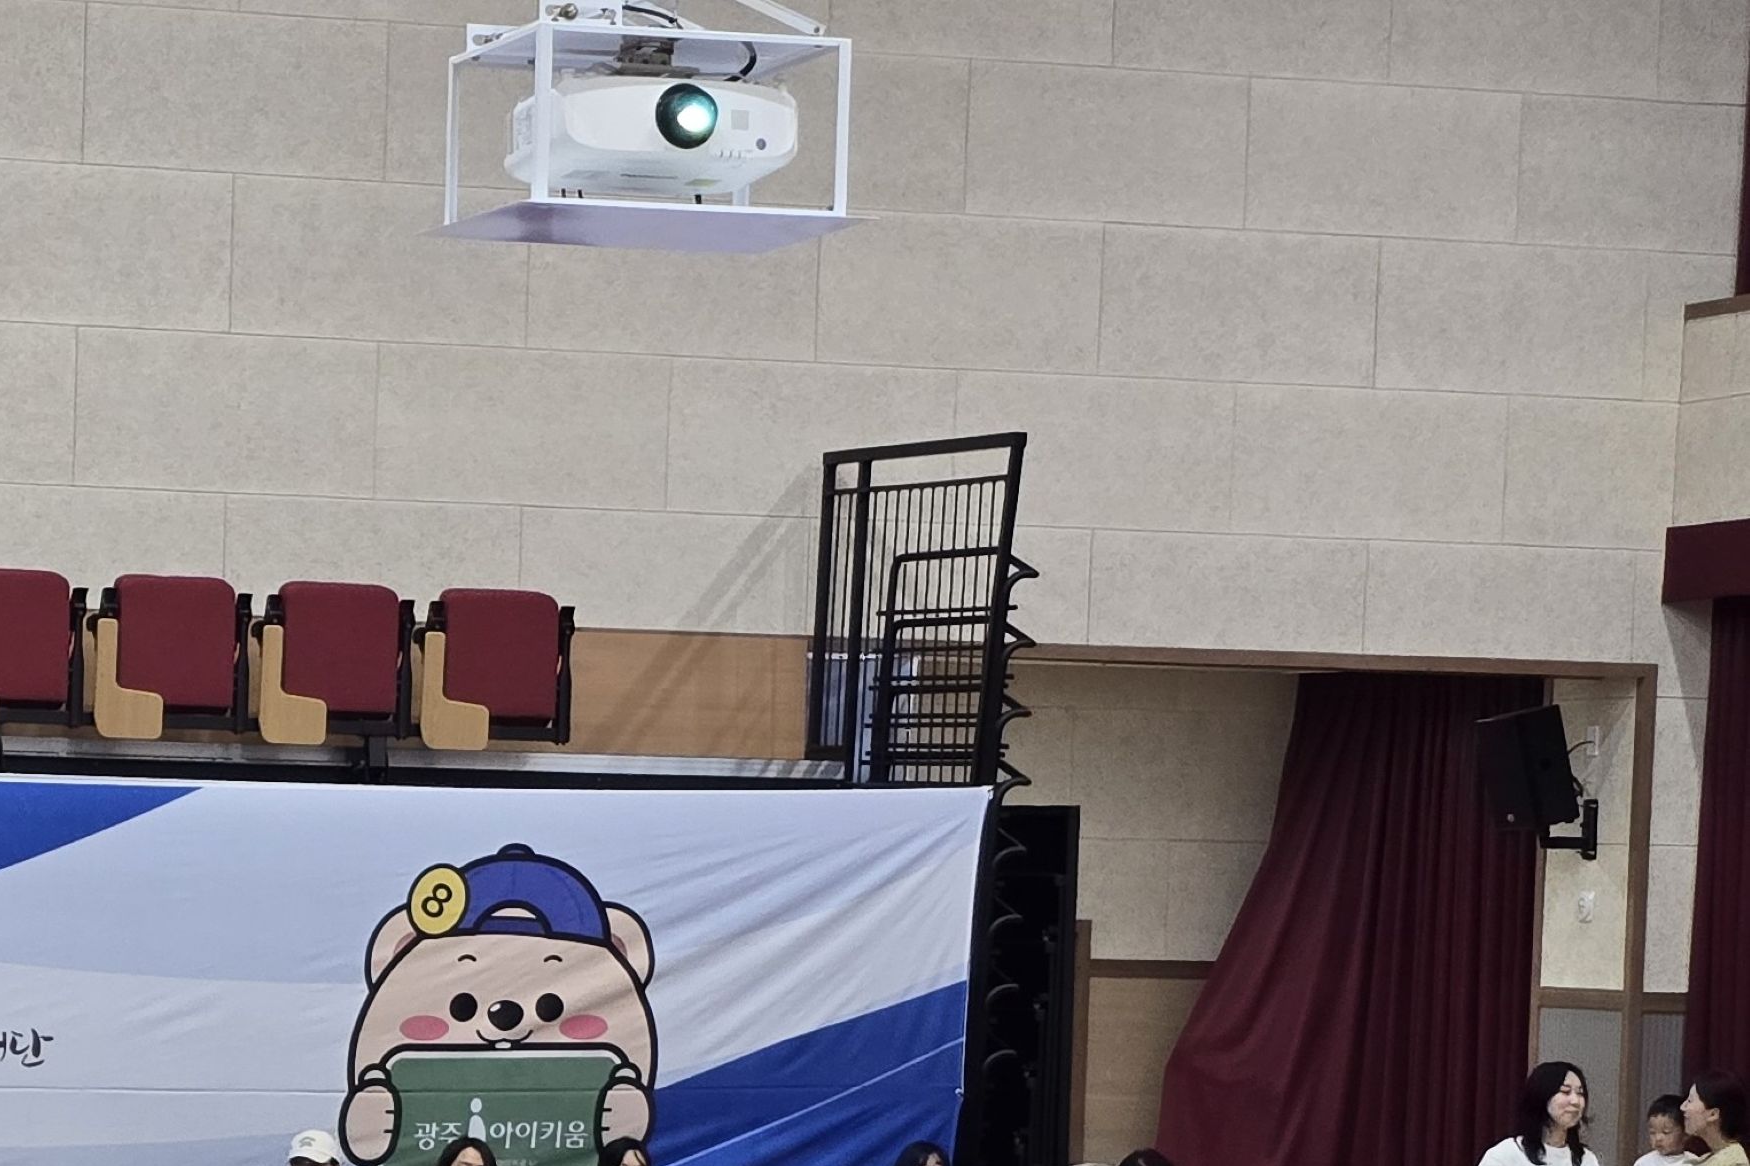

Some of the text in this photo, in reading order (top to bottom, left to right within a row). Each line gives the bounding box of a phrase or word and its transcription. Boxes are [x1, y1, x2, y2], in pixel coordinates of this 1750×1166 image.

[420, 881, 453, 919] 8
[414, 1120, 588, 1151] 광주 아이키움
